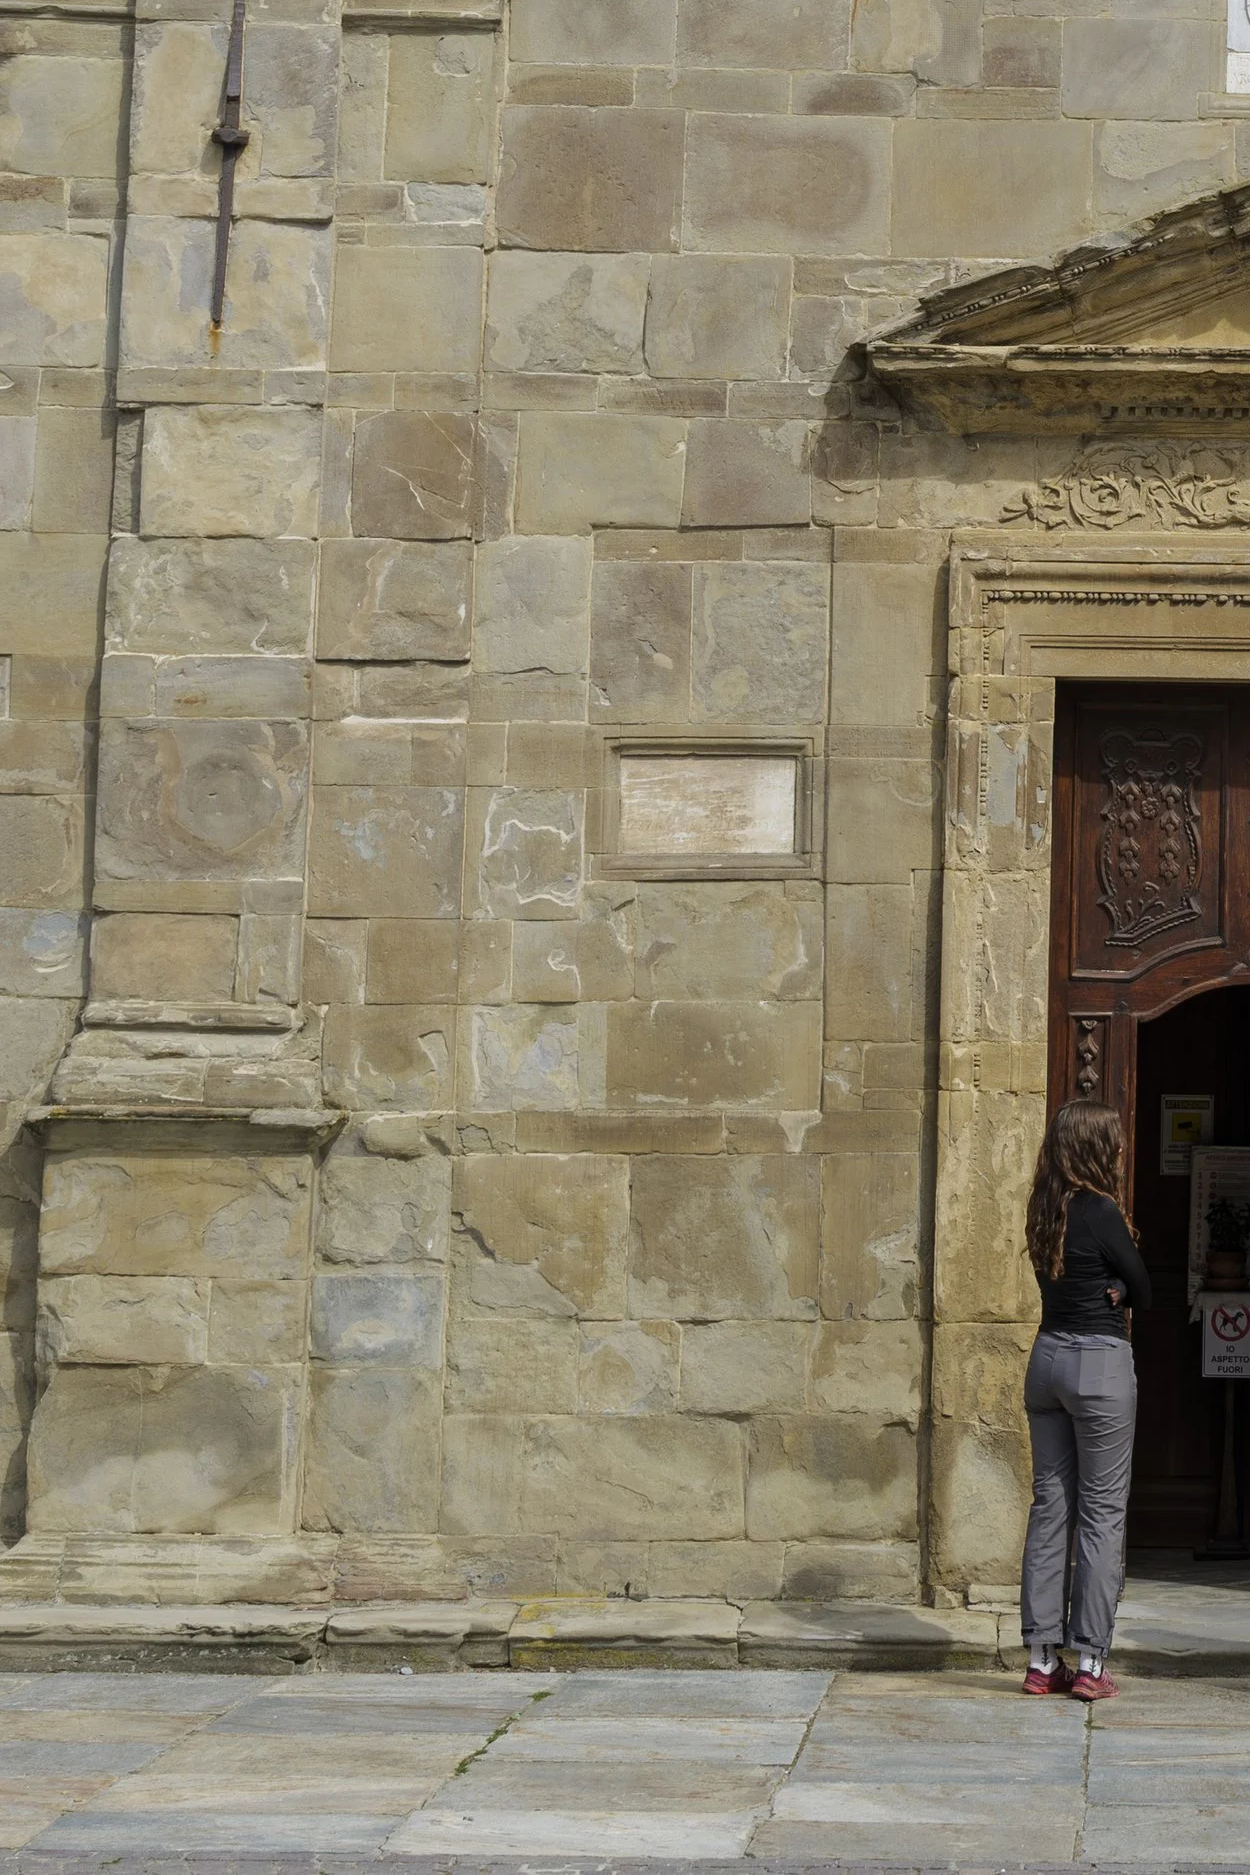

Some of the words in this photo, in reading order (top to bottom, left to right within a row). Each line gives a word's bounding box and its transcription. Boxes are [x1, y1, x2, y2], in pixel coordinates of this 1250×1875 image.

[1225, 1345, 1235, 1353] IO
[1211, 1355, 1250, 1363] ASPETTO
[1217, 1365, 1243, 1373] FUORI
